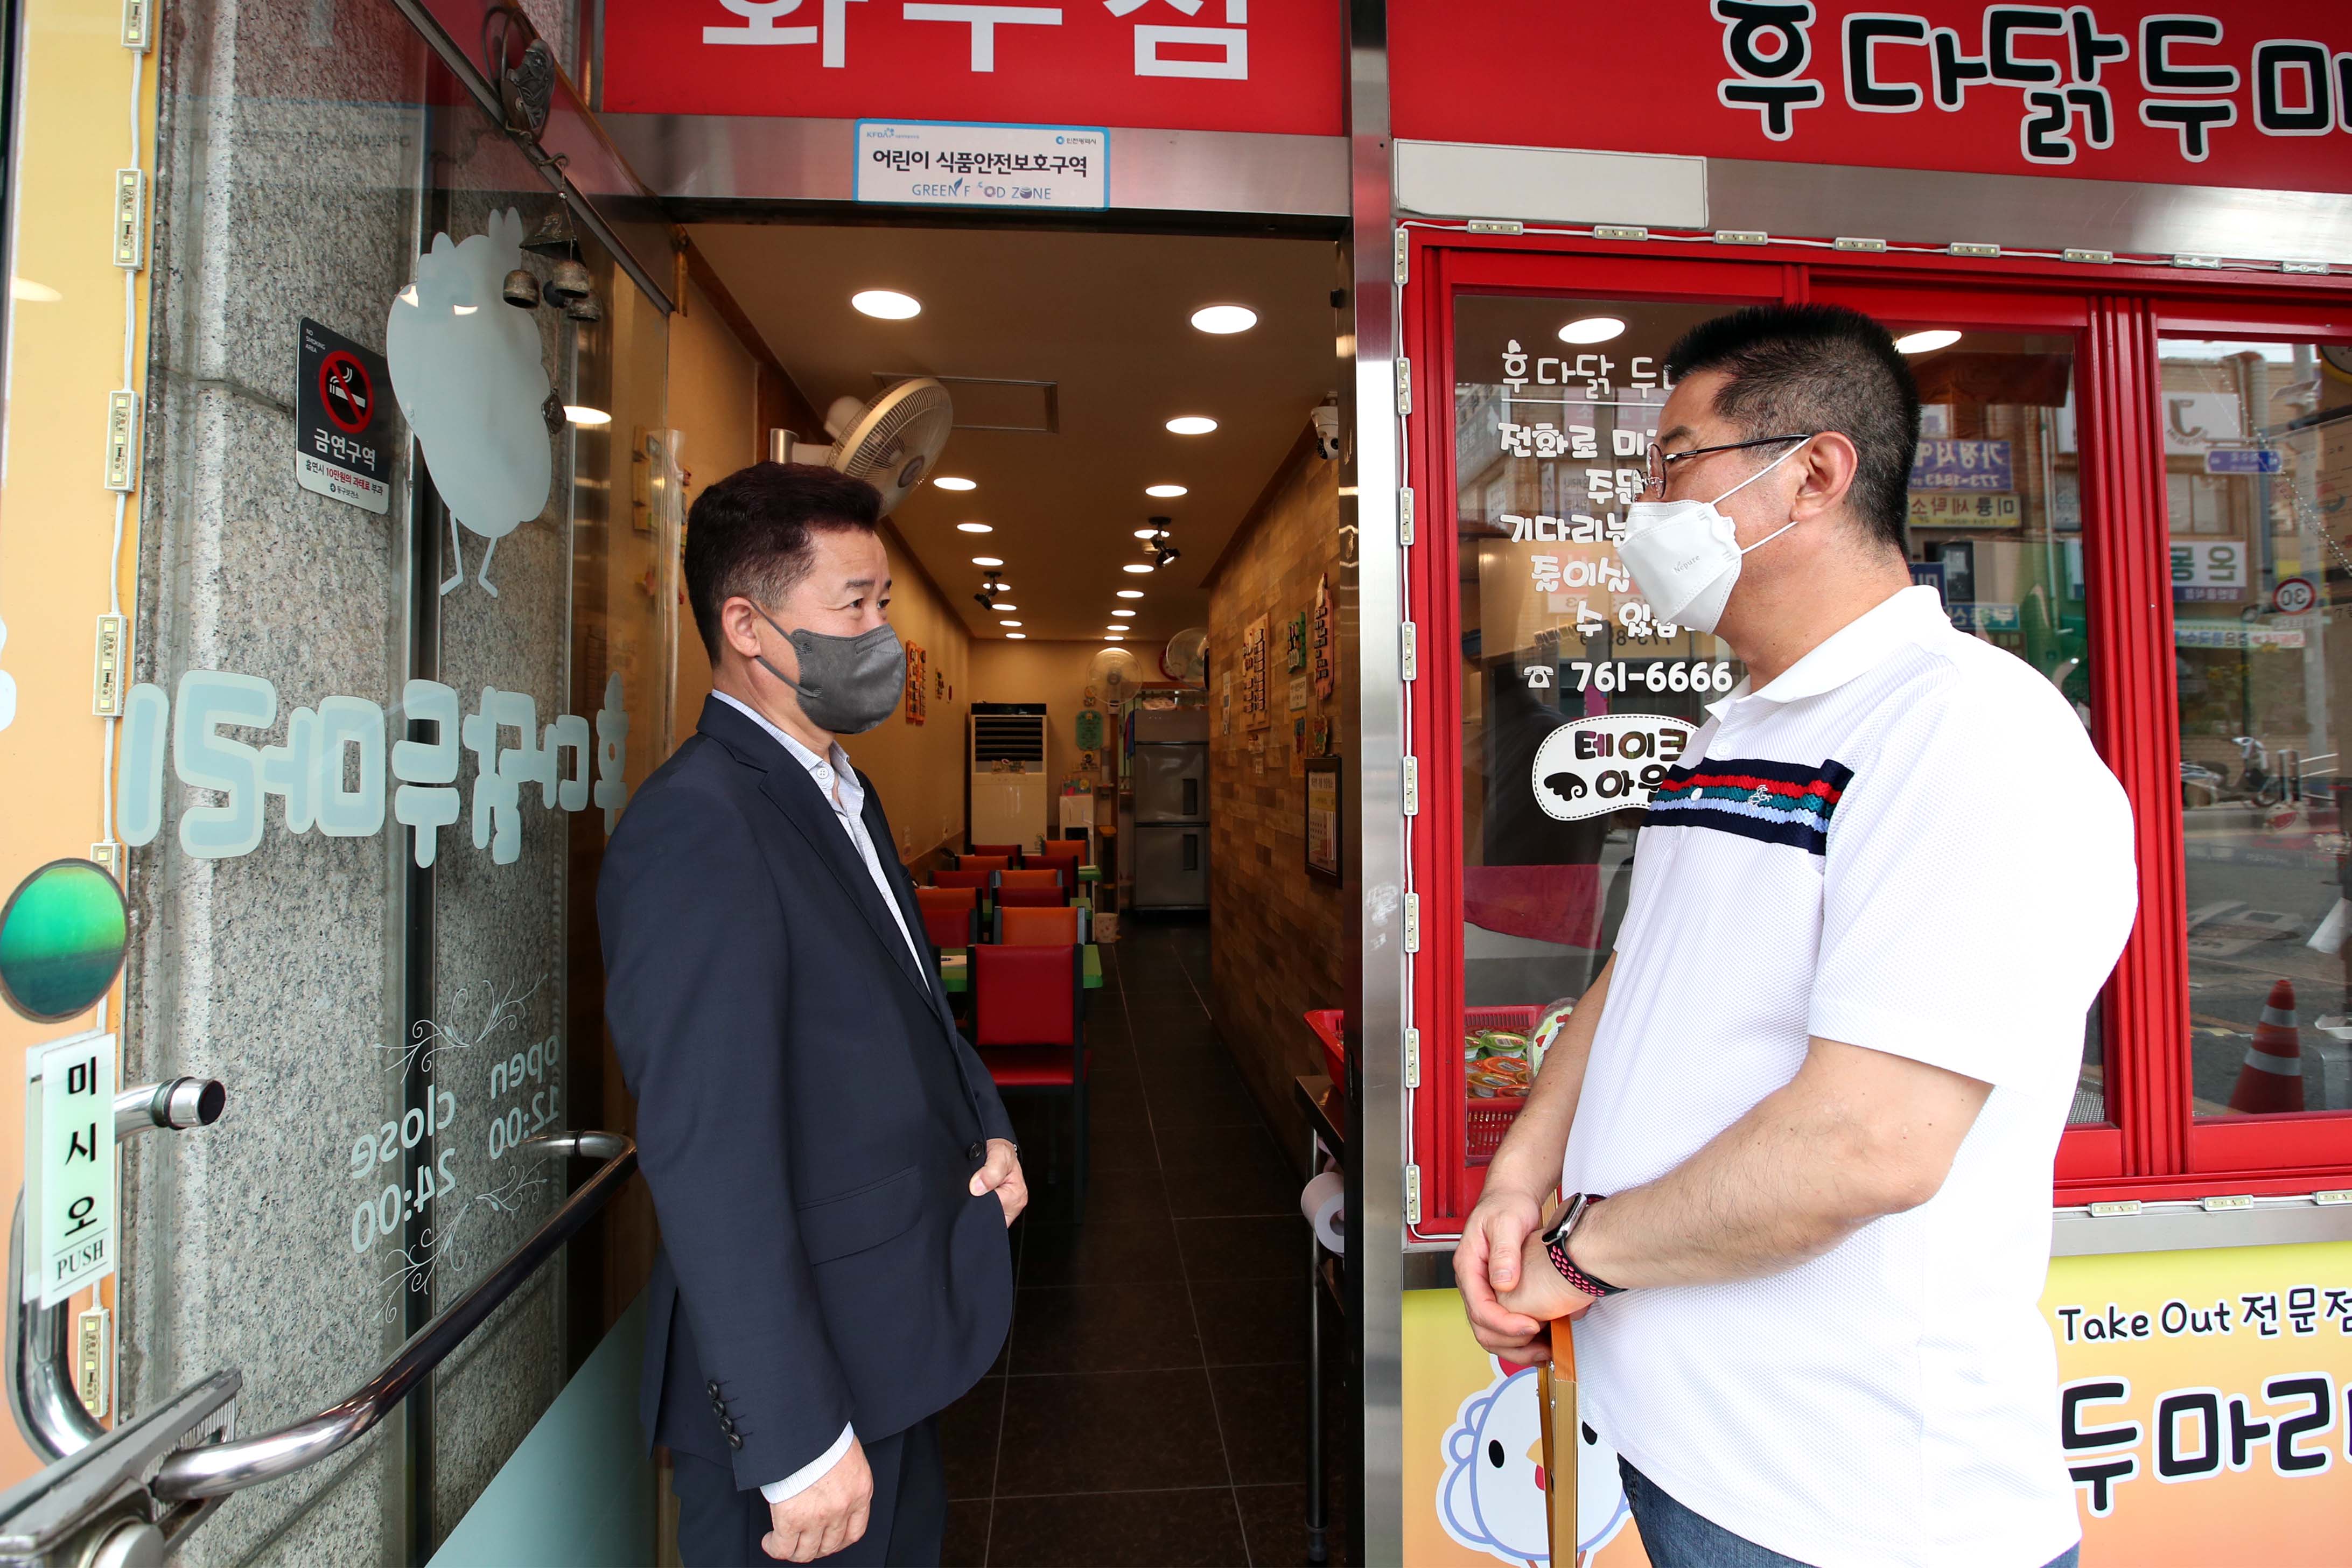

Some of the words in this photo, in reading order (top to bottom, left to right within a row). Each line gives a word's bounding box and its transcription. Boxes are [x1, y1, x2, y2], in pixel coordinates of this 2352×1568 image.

[1066, 137, 1097, 145] 인천광역시
[872, 150, 929, 172] 어린이
[935, 152, 1087, 178] 식품안전보호구역
[912, 181, 960, 197] GREEN
[964, 181, 1006, 199] FOD
[1012, 186, 1052, 200] ZONE
[305, 335, 326, 351] SMOKING
[306, 328, 313, 336] NO
[305, 344, 318, 354] AREA
[1501, 339, 1615, 399] 후다닭
[1630, 356, 1674, 398] 두
[314, 428, 376, 472] 금연구역
[1497, 422, 1598, 458] 전화로
[1612, 429, 1657, 457] 미
[326, 467, 352, 485] 10만원의
[337, 486, 360, 500] 동구보건소
[1673, 555, 1700, 573] Nepure
[1576, 600, 1603, 637] 수
[1571, 661, 1733, 692] 761-6666
[1574, 728, 1688, 761] 테이크
[64, 1055, 98, 1237] 미시오
[57, 1238, 104, 1280] PUSH
[2058, 1305, 2150, 1341] Take
[2161, 1301, 2231, 1334] Out
